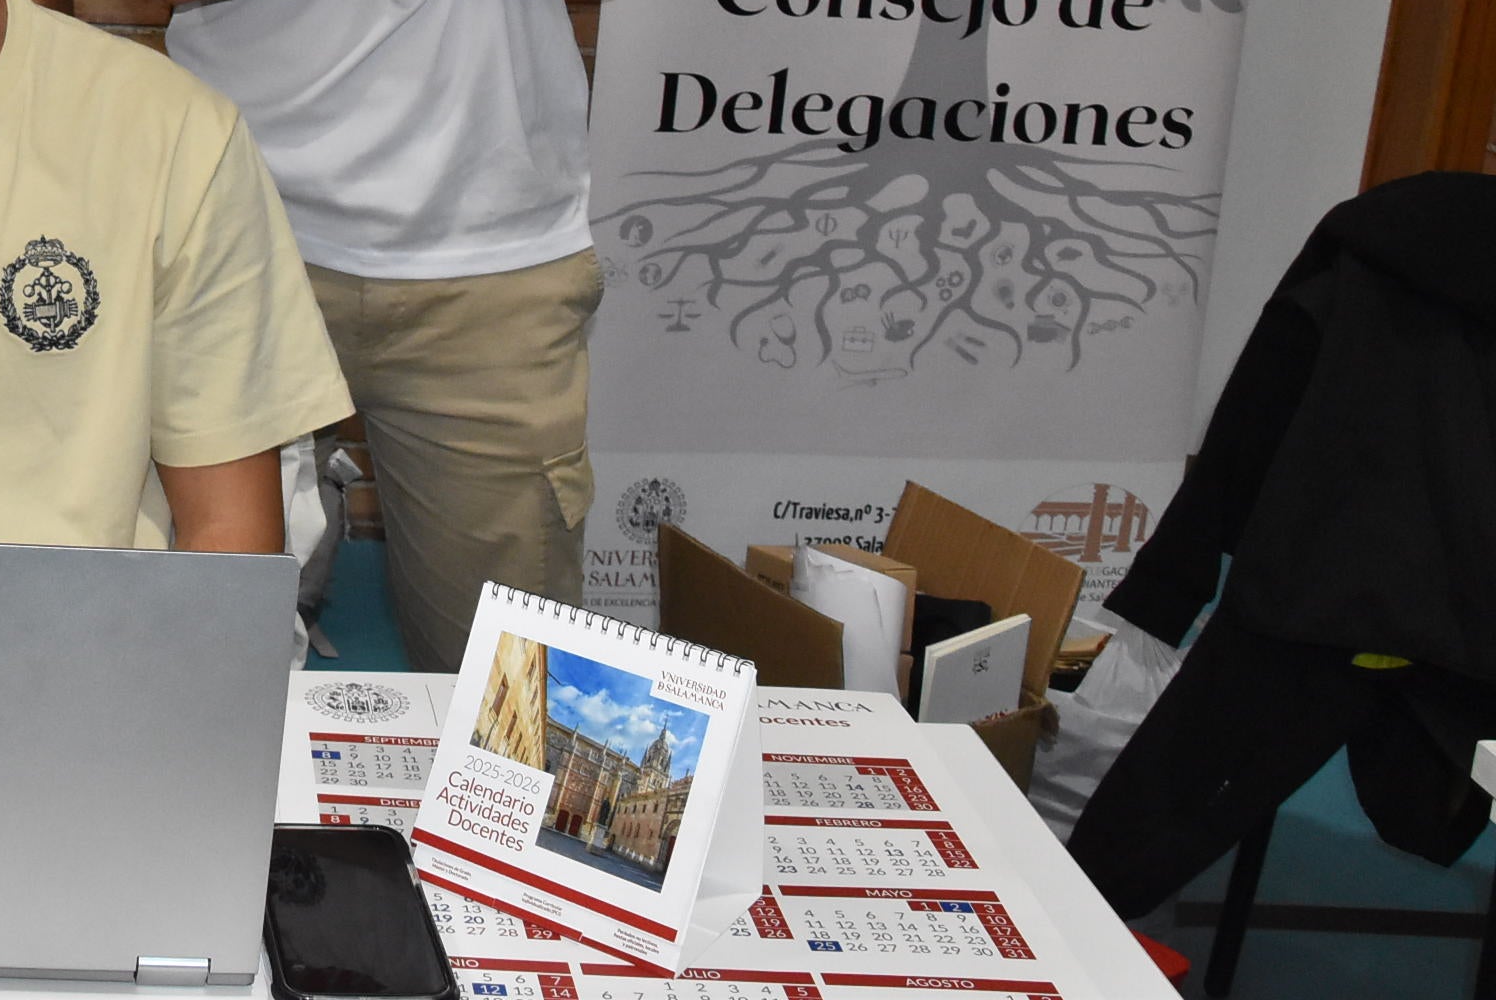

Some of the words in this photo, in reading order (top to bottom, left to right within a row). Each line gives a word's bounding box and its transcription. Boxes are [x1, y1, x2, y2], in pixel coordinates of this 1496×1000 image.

[654, 67, 1195, 154] Delegaciones
[665, 683, 724, 712] SALAMANCA
[771, 754, 854, 765] NOVIEMBRE
[464, 754, 540, 795] 2025-2026
[448, 771, 534, 816] Calendario
[436, 786, 530, 834] Actividades
[447, 808, 524, 852] Docentes
[815, 818, 883, 828] FEBRERO
[866, 888, 913, 899] MAYO
[431, 903, 450, 912] 12
[462, 905, 482, 914] 13
[920, 903, 929, 911] 1
[950, 903, 960, 912] 2
[983, 905, 994, 914] 3
[434, 914, 453, 922] 19
[464, 916, 485, 925] 20
[495, 918, 516, 926] 21
[804, 910, 814, 918] 4
[834, 911, 845, 919] 5
[866, 911, 876, 920] 6
[894, 912, 904, 920] 7
[926, 913, 937, 922] 8
[957, 914, 966, 923] 9
[987, 915, 1007, 925] 10
[466, 927, 486, 936] 27
[499, 929, 518, 938] 28
[531, 930, 553, 940] 29
[807, 920, 825, 929] 11
[836, 921, 856, 930] 12
[866, 922, 887, 931] 13
[897, 923, 917, 932] 14
[928, 924, 948, 933] 15
[960, 925, 979, 935] 16
[993, 926, 1012, 936] 17
[810, 931, 830, 940] 18
[841, 932, 861, 941] 19
[872, 932, 893, 942] 20
[903, 934, 924, 943] 21
[934, 935, 956, 944] 22
[967, 936, 987, 945] 23
[999, 937, 1021, 947] 24
[815, 941, 836, 951] 25
[848, 943, 868, 952] 26
[877, 944, 897, 953] 27
[909, 945, 931, 954] 28
[939, 946, 961, 955] 29
[971, 947, 993, 957] 30
[1005, 949, 1028, 959] 31
[482, 973, 493, 982] 5
[515, 975, 526, 984] 6
[550, 977, 561, 986] 7
[680, 970, 721, 980] ULIO
[664, 982, 674, 991] 1
[696, 983, 708, 992] 2
[728, 984, 740, 994] 3
[761, 986, 772, 995] 4
[796, 987, 808, 997] 5
[906, 977, 975, 989] AGOSTO
[480, 985, 502, 995] 12
[514, 986, 535, 997] 13
[550, 988, 571, 999] 14
